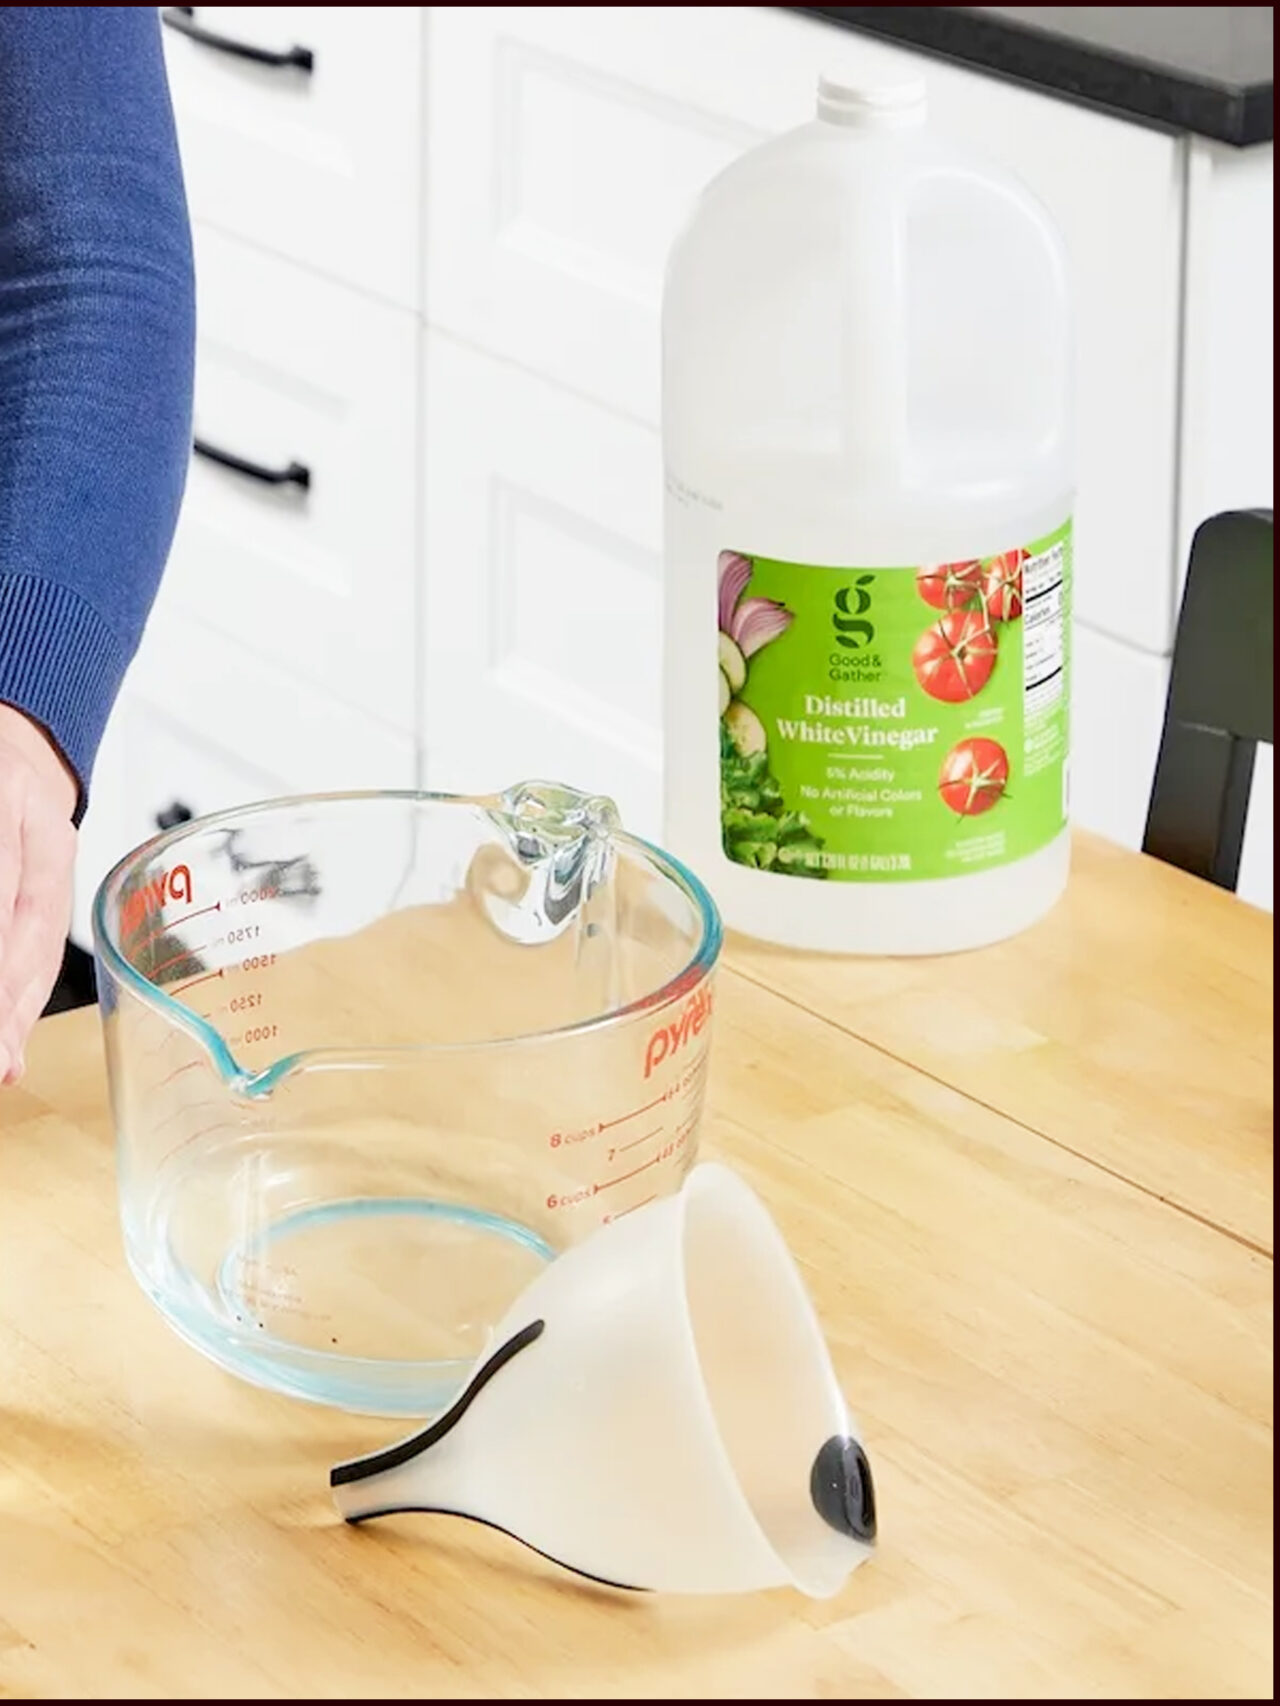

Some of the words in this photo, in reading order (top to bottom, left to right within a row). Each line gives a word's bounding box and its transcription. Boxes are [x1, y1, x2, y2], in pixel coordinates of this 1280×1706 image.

[829, 653, 870, 667] Good
[872, 654, 882, 667] &
[829, 668, 882, 682] Gather
[805, 695, 906, 718] Distilled
[776, 718, 845, 744] White
[845, 725, 939, 751] Vinegar
[826, 767, 846, 779] 5%
[848, 768, 895, 782] Acidity
[800, 785, 819, 798] No
[822, 787, 877, 801] Artificial
[881, 789, 922, 801] Colors
[830, 806, 843, 817] or
[847, 804, 893, 818] Flavors
[550, 1133, 561, 1148] 8
[547, 1194, 558, 1209] 6
